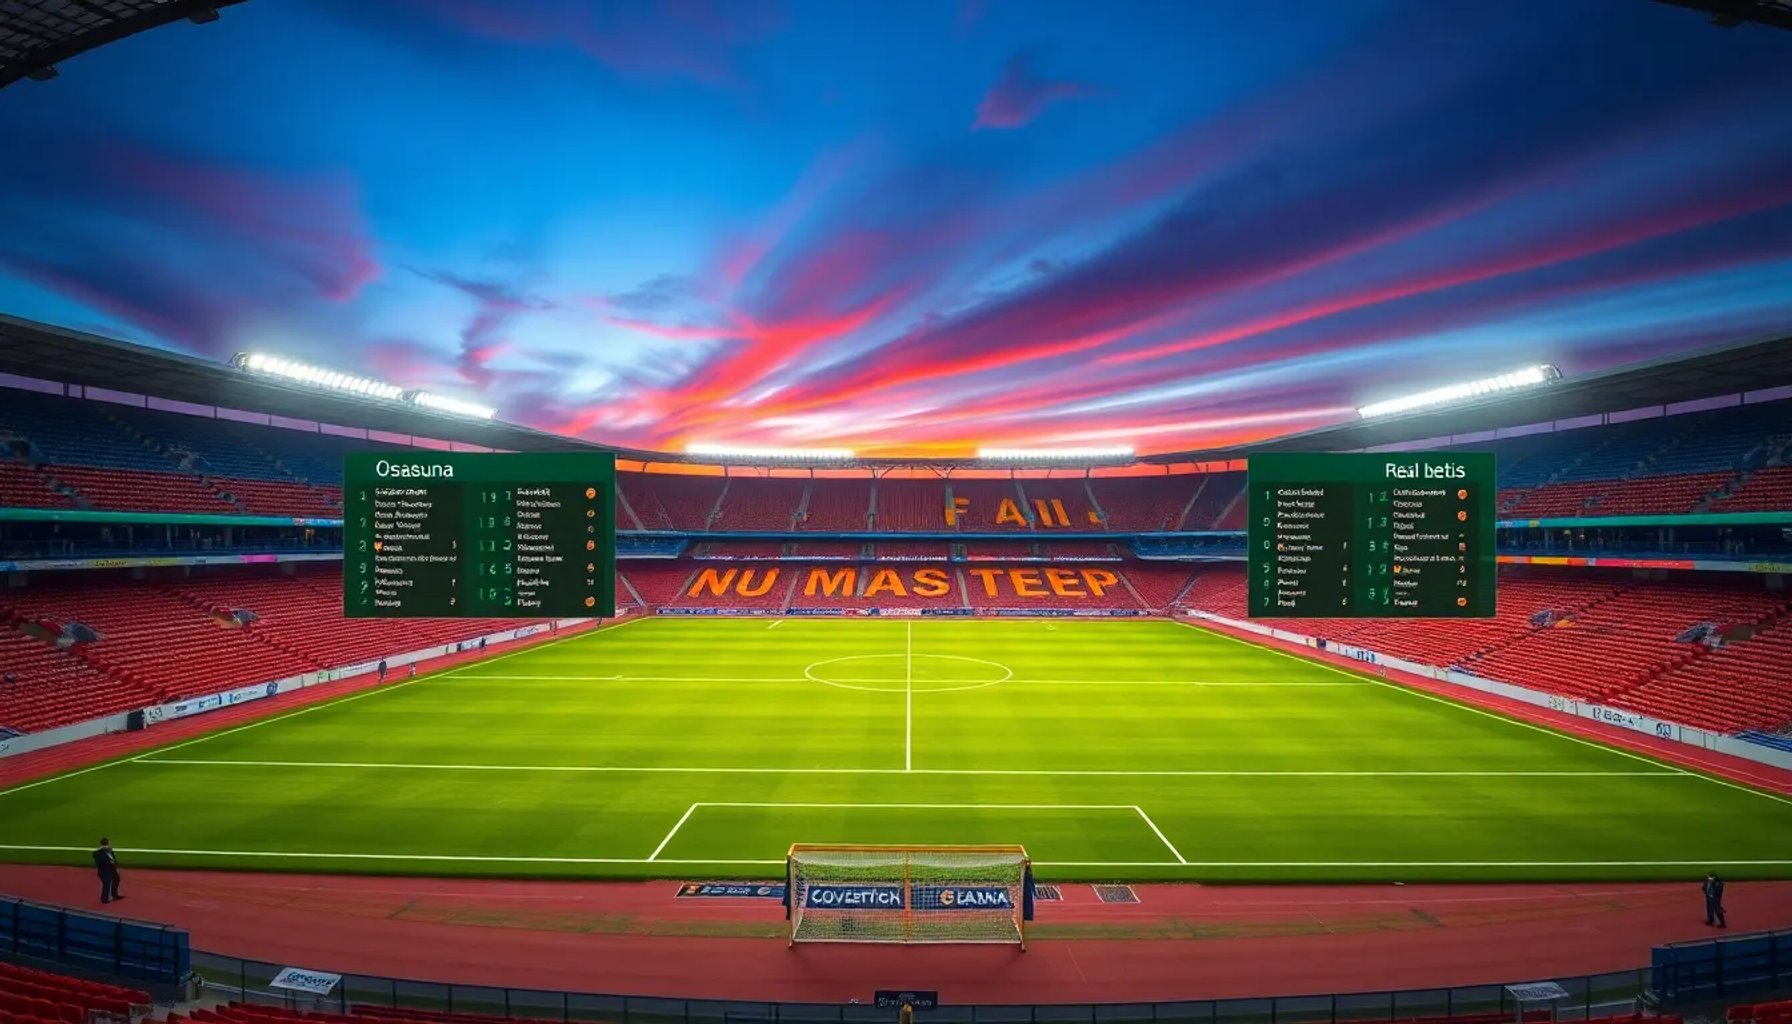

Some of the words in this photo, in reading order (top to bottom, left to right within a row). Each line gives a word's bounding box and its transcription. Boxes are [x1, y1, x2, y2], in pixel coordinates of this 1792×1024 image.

[376, 460, 454, 477] Osasuna
[1385, 463, 1419, 478] Real
[1424, 463, 1466, 478] betis
[687, 570, 780, 598] NU
[803, 568, 950, 598] MAS
[969, 568, 1119, 598] TEEP
